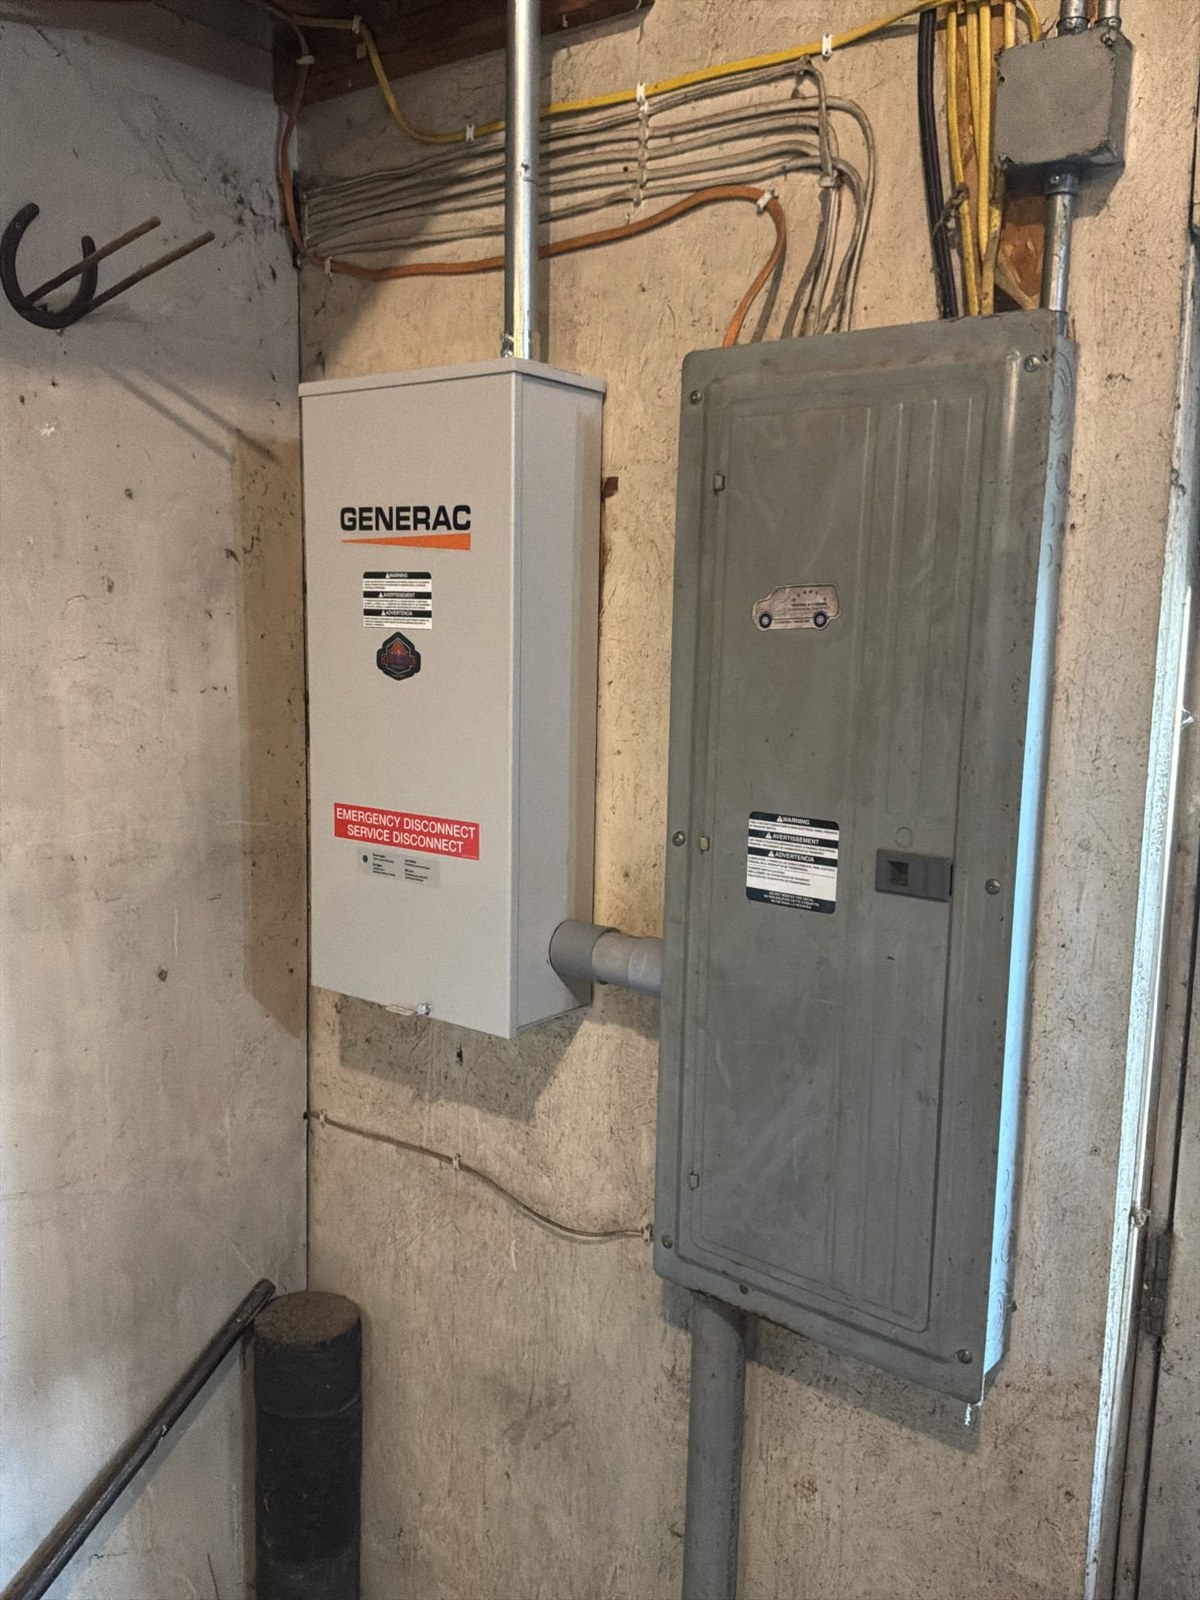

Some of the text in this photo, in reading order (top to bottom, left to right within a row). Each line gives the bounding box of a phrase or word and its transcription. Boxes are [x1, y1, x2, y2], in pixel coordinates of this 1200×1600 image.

[340, 505, 471, 531] GENERAC
[336, 807, 475, 839] EMERGENCY DISCONNECT
[782, 816, 810, 825] WARNING
[347, 824, 464, 853] SERVICE DISCONNECT
[772, 833, 820, 845] AVERTISSEMENT
[774, 852, 815, 862] ADVERTENCIA
